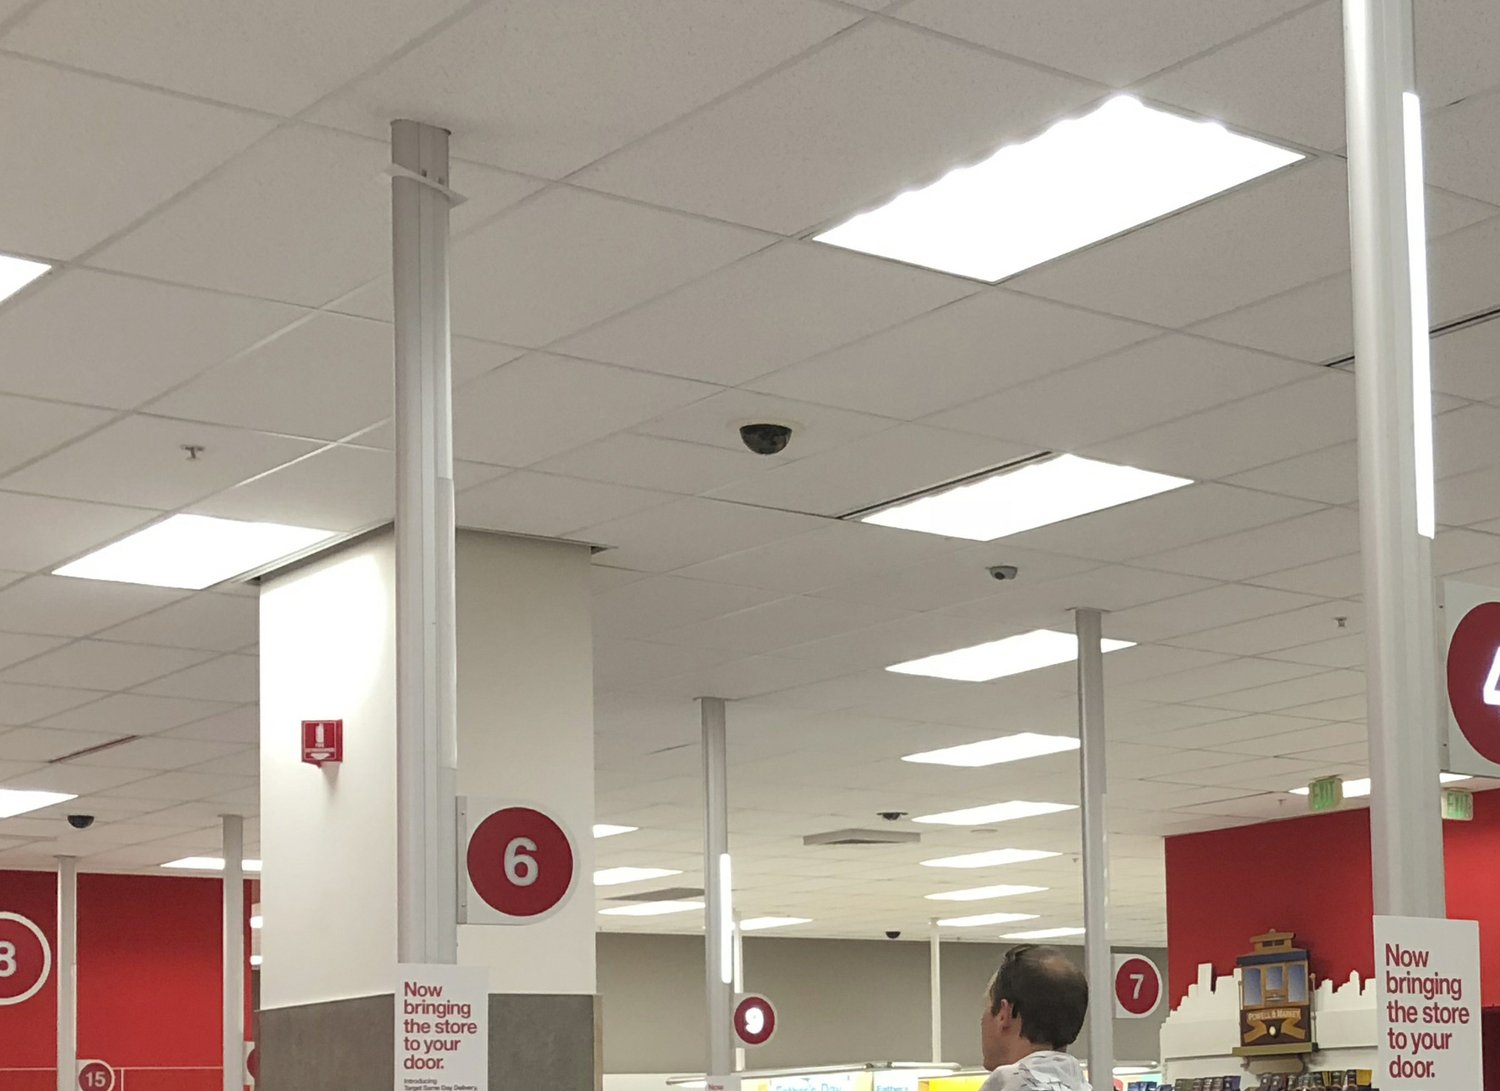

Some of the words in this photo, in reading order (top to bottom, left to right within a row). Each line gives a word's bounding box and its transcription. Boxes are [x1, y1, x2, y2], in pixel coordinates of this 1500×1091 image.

[503, 837, 539, 887] 6
[1385, 943, 1429, 967] Now
[404, 981, 443, 997] Now
[1129, 974, 1145, 999] 7
[1386, 970, 1462, 1000] bringing
[403, 999, 471, 1019] bringing
[744, 1007, 764, 1034] 9
[1387, 1000, 1418, 1023] the
[1422, 1002, 1470, 1024] store
[403, 1018, 431, 1034] the
[435, 1019, 478, 1034] store
[403, 1036, 421, 1051] to
[424, 1039, 461, 1054] your
[1387, 1027, 1407, 1049] to
[1410, 1032, 1453, 1055] your
[403, 1054, 444, 1070] door.
[1389, 1055, 1436, 1078] door.
[85, 1072, 106, 1087] 15
